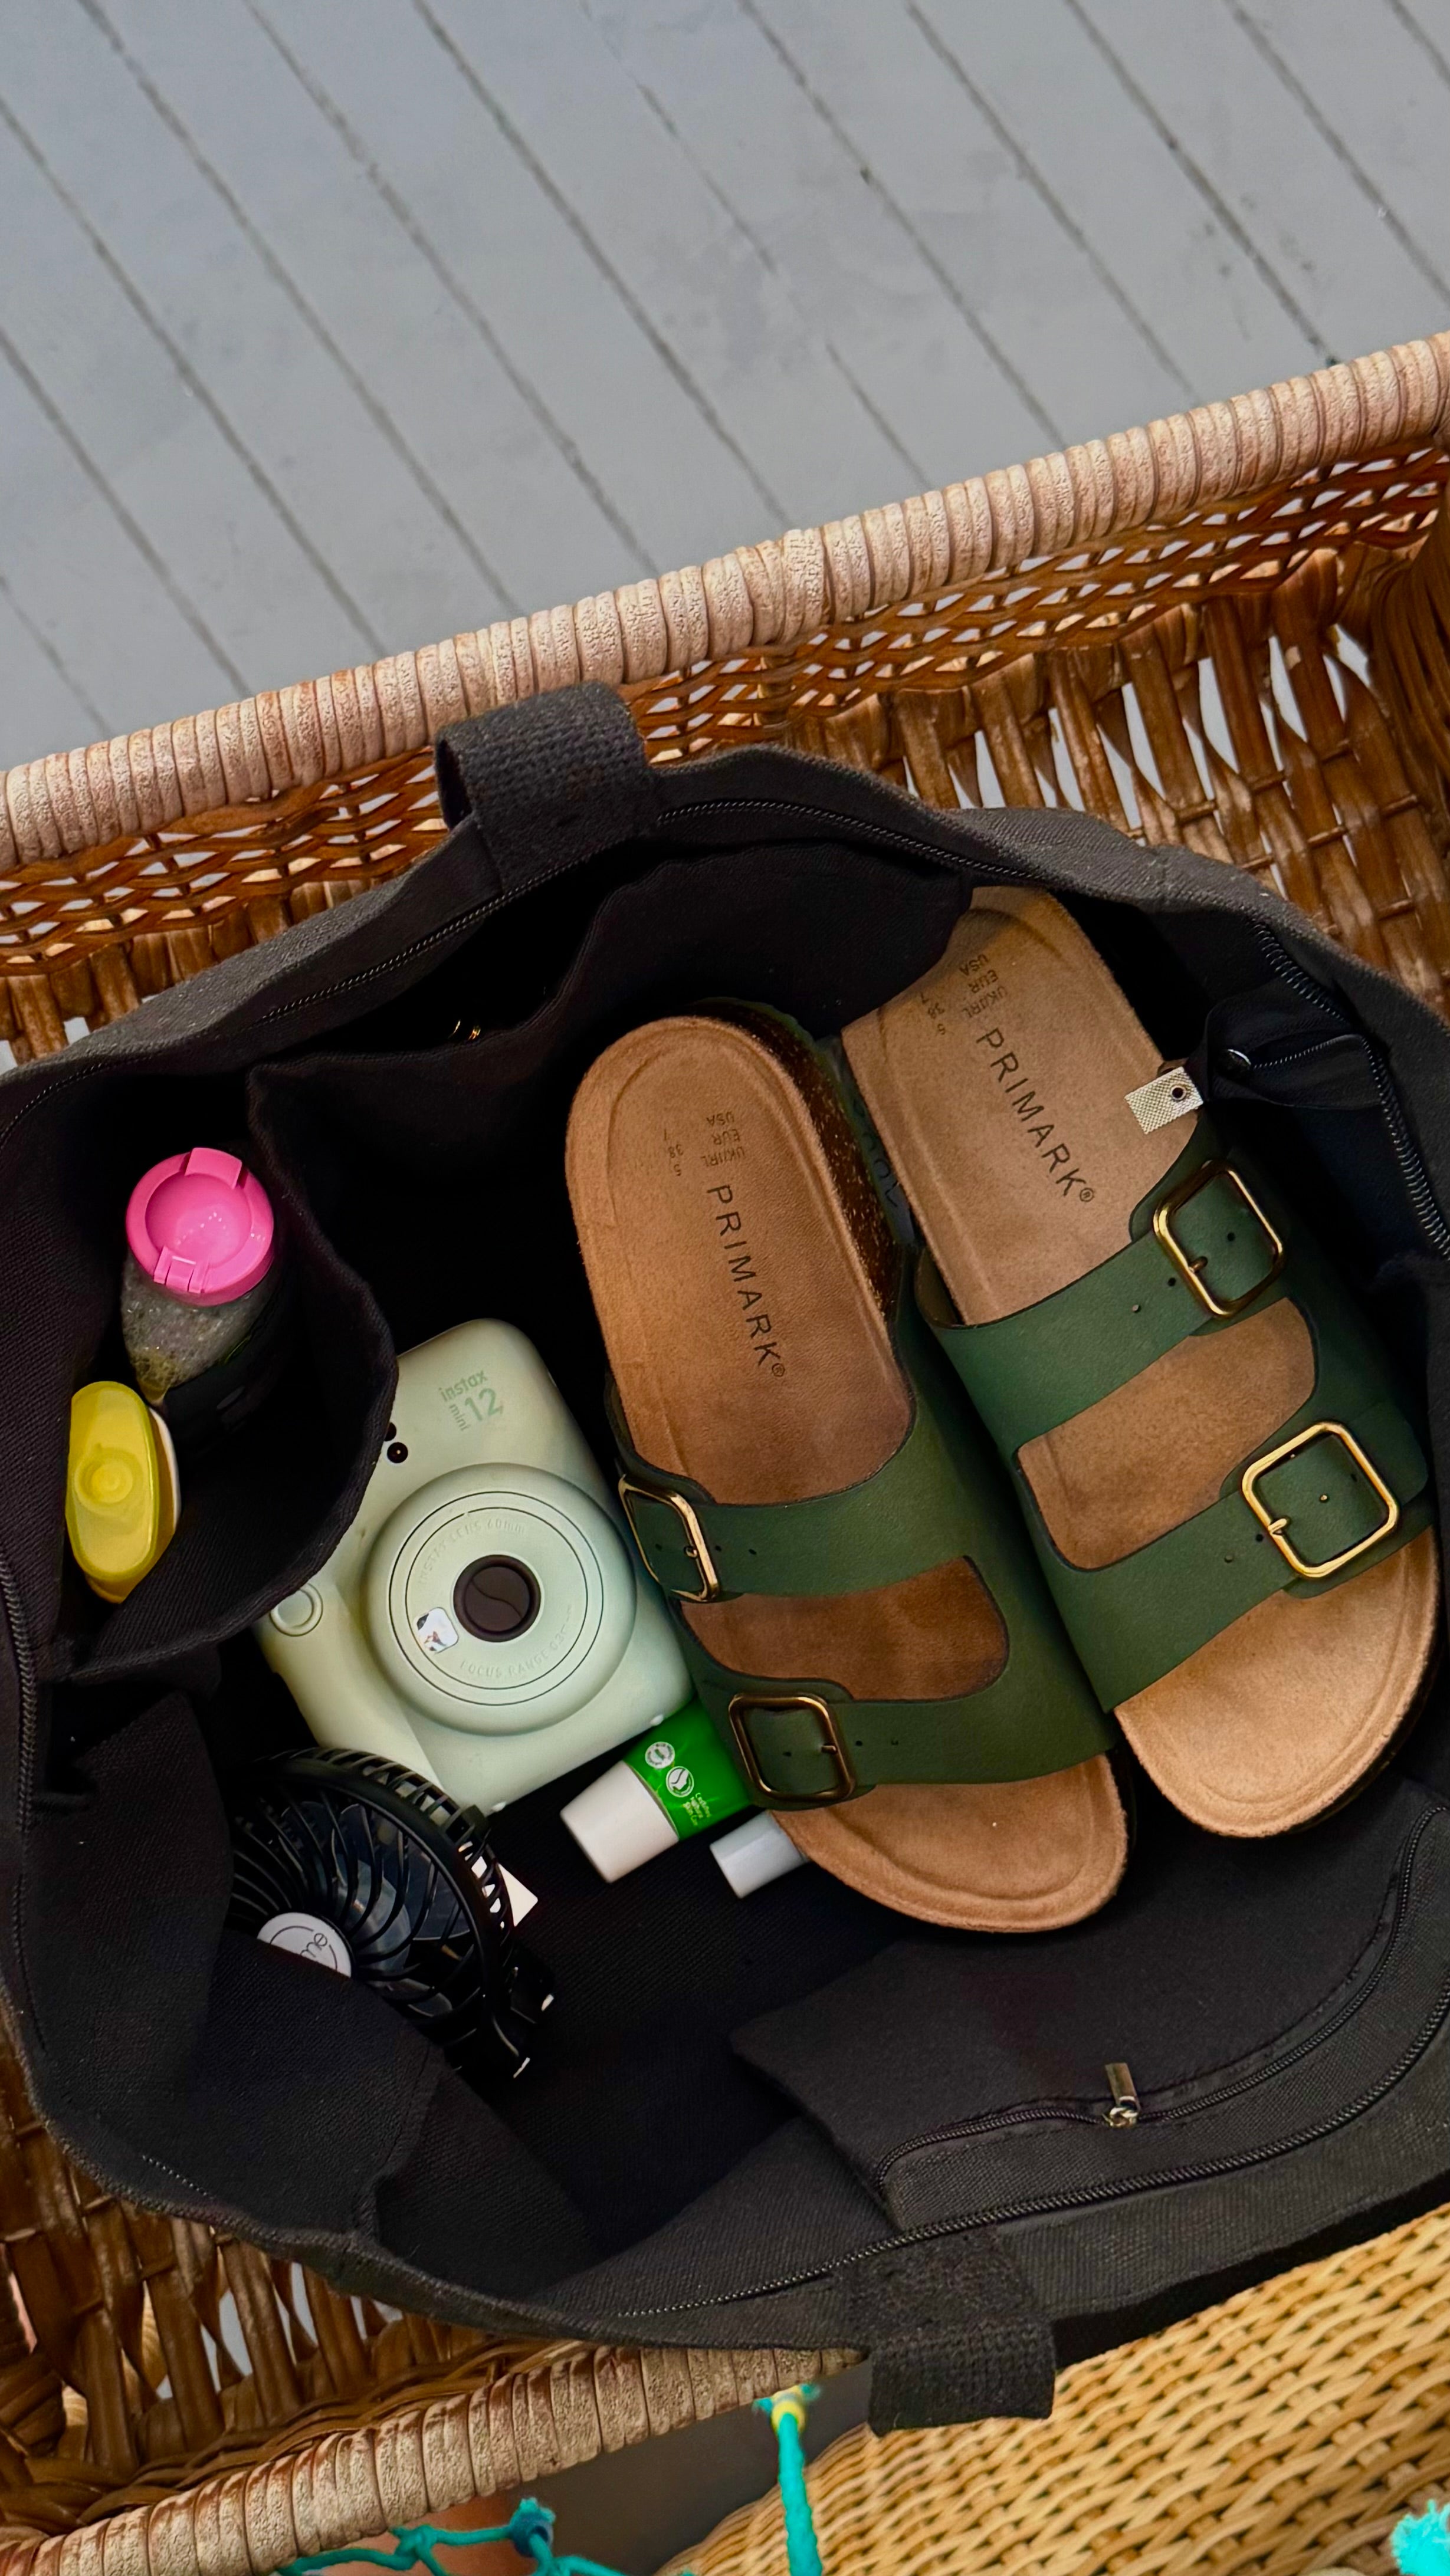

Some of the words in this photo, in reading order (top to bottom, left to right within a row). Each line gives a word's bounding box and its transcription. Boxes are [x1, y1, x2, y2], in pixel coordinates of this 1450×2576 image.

[959, 954, 989, 976] USA
[968, 970, 999, 993] EUR
[920, 992, 930, 1004] 7
[928, 1003, 945, 1020] 38
[706, 1111, 734, 1126] USA
[711, 1129, 740, 1145] EUR
[668, 1144, 684, 1159] 38
[674, 1164, 681, 1177] 5
[438, 1370, 488, 1402] instax
[449, 1404, 471, 1431] mini
[464, 1388, 504, 1422] 12
[460, 1660, 502, 1677] FOCUS
[509, 1650, 549, 1675] RANGE
